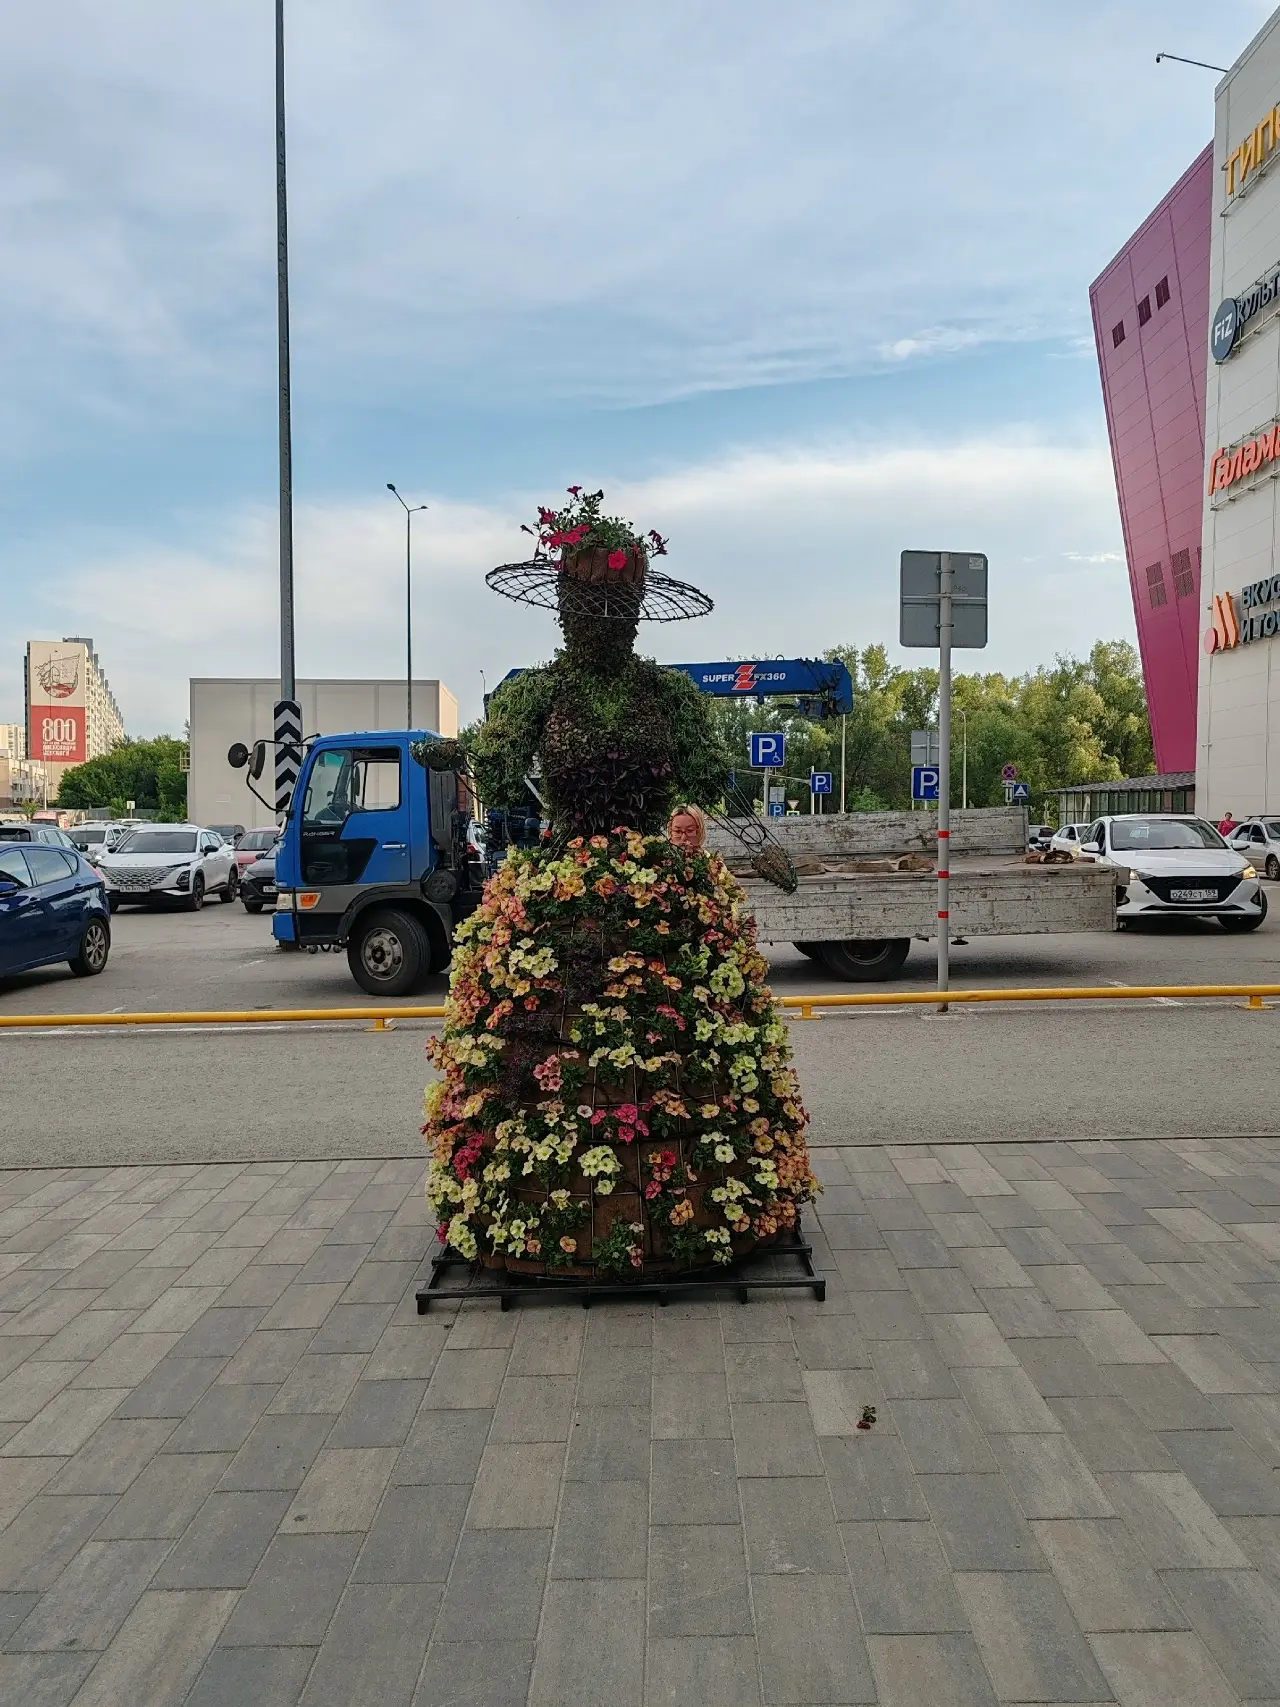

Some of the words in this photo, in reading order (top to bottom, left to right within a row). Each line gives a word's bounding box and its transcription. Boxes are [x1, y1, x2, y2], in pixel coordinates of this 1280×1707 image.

[702, 674, 735, 683] SUPER
[754, 672, 786, 681] FX360
[42, 717, 76, 742] 800
[758, 737, 777, 763] P
[815, 775, 827, 792] P
[919, 771, 939, 796] P
